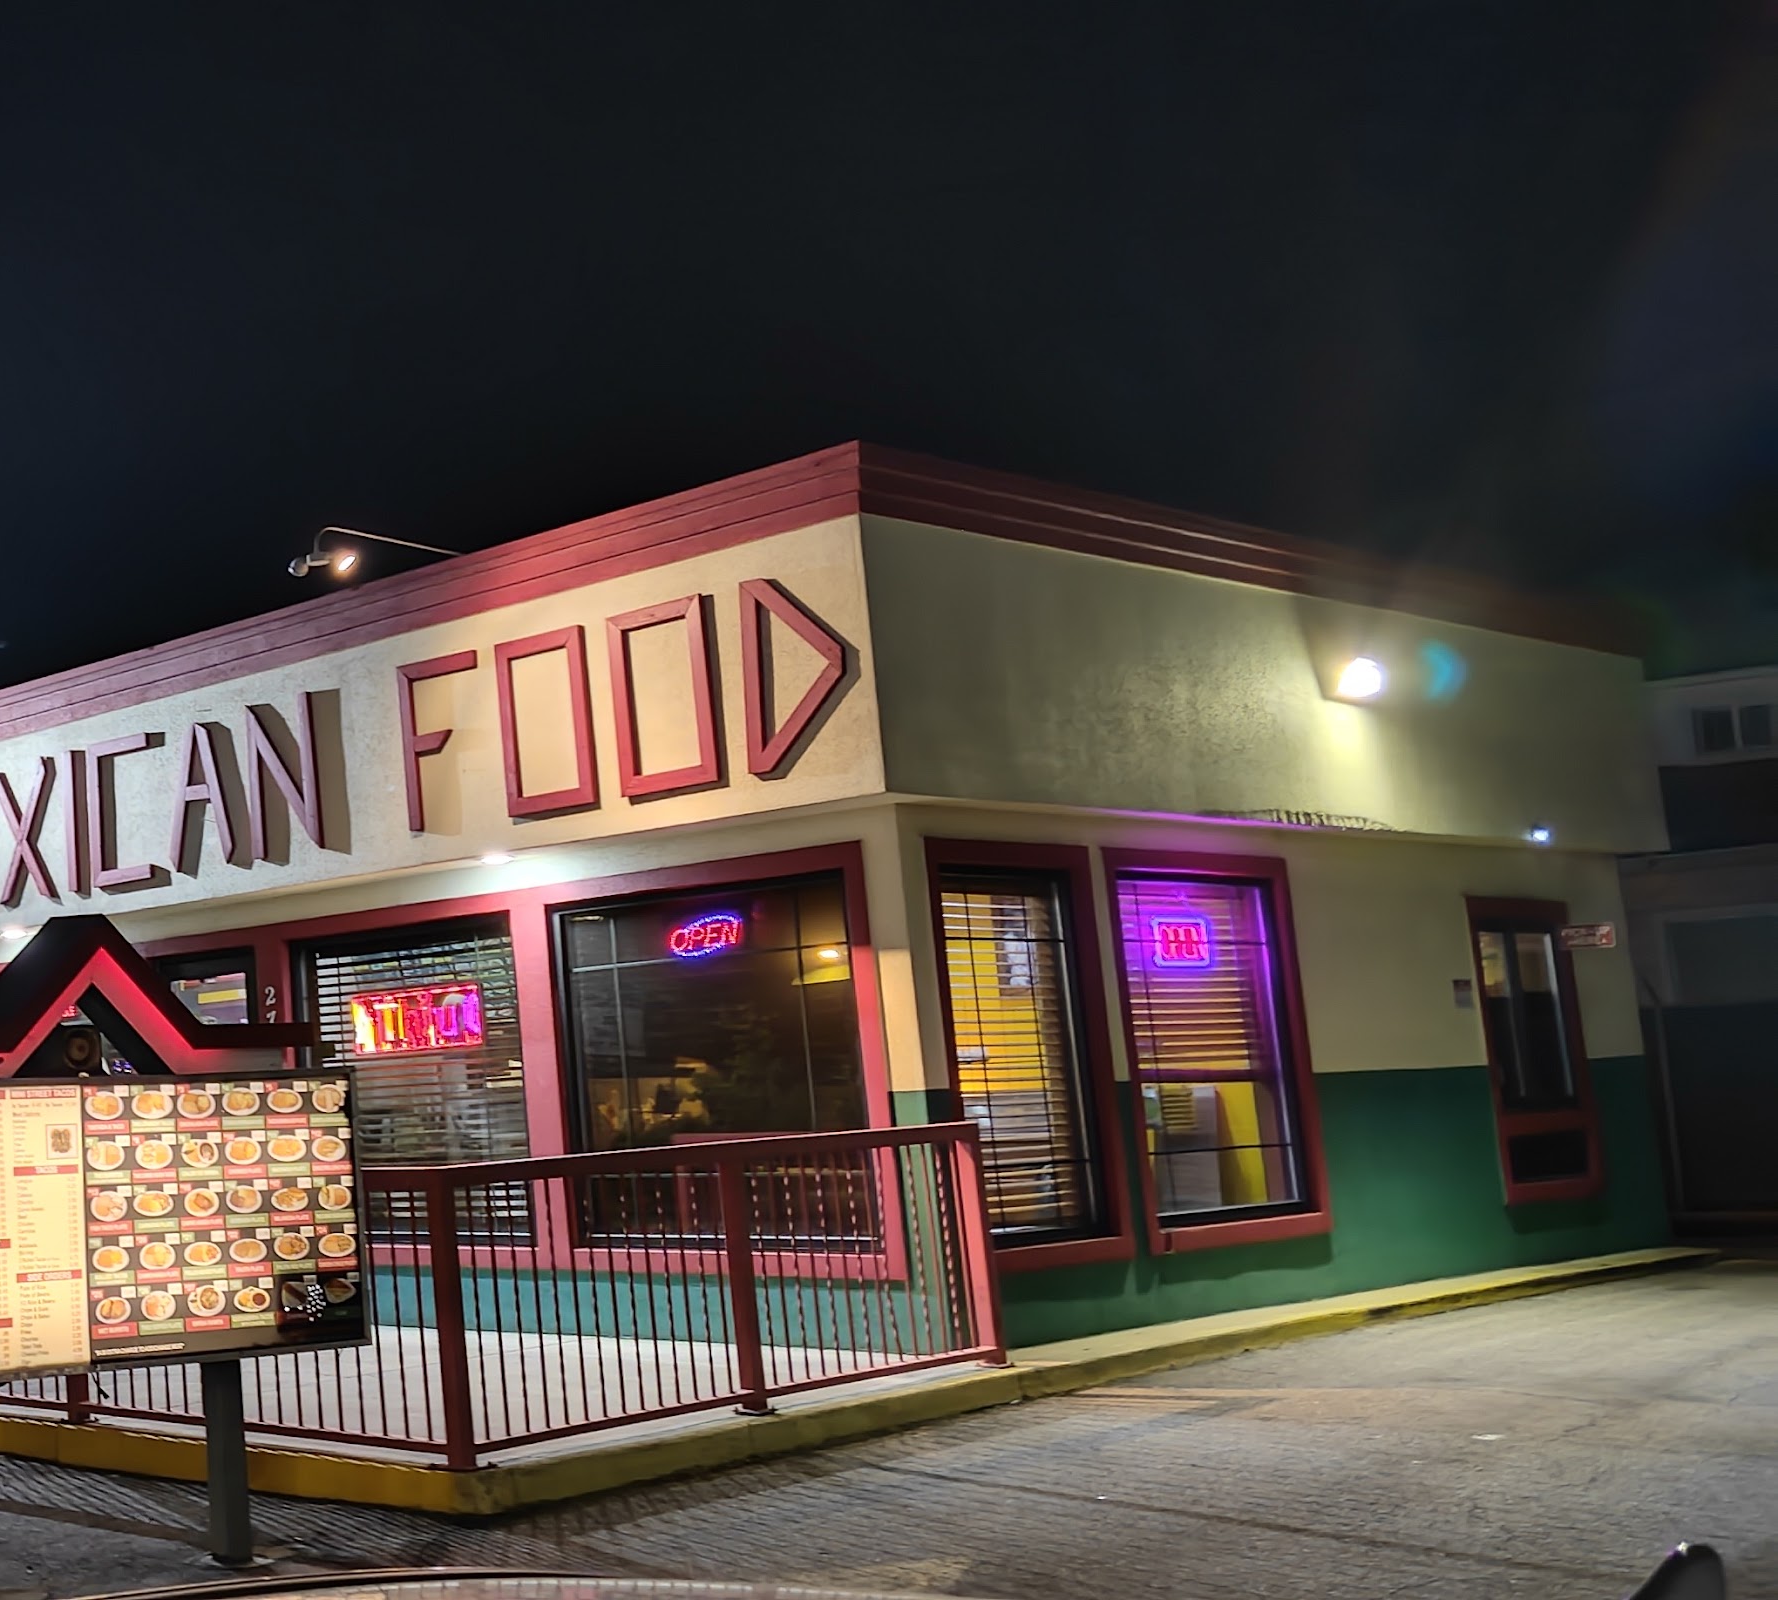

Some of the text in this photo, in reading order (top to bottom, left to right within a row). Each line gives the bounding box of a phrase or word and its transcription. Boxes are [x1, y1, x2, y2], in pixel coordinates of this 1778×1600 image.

[396, 578, 846, 831] FOOD
[670, 920, 739, 951] OPEN
[27, 1089, 52, 1098] STREET
[53, 1089, 76, 1097] TACOS
[27, 1271, 72, 1281] SIDE ORDERS
